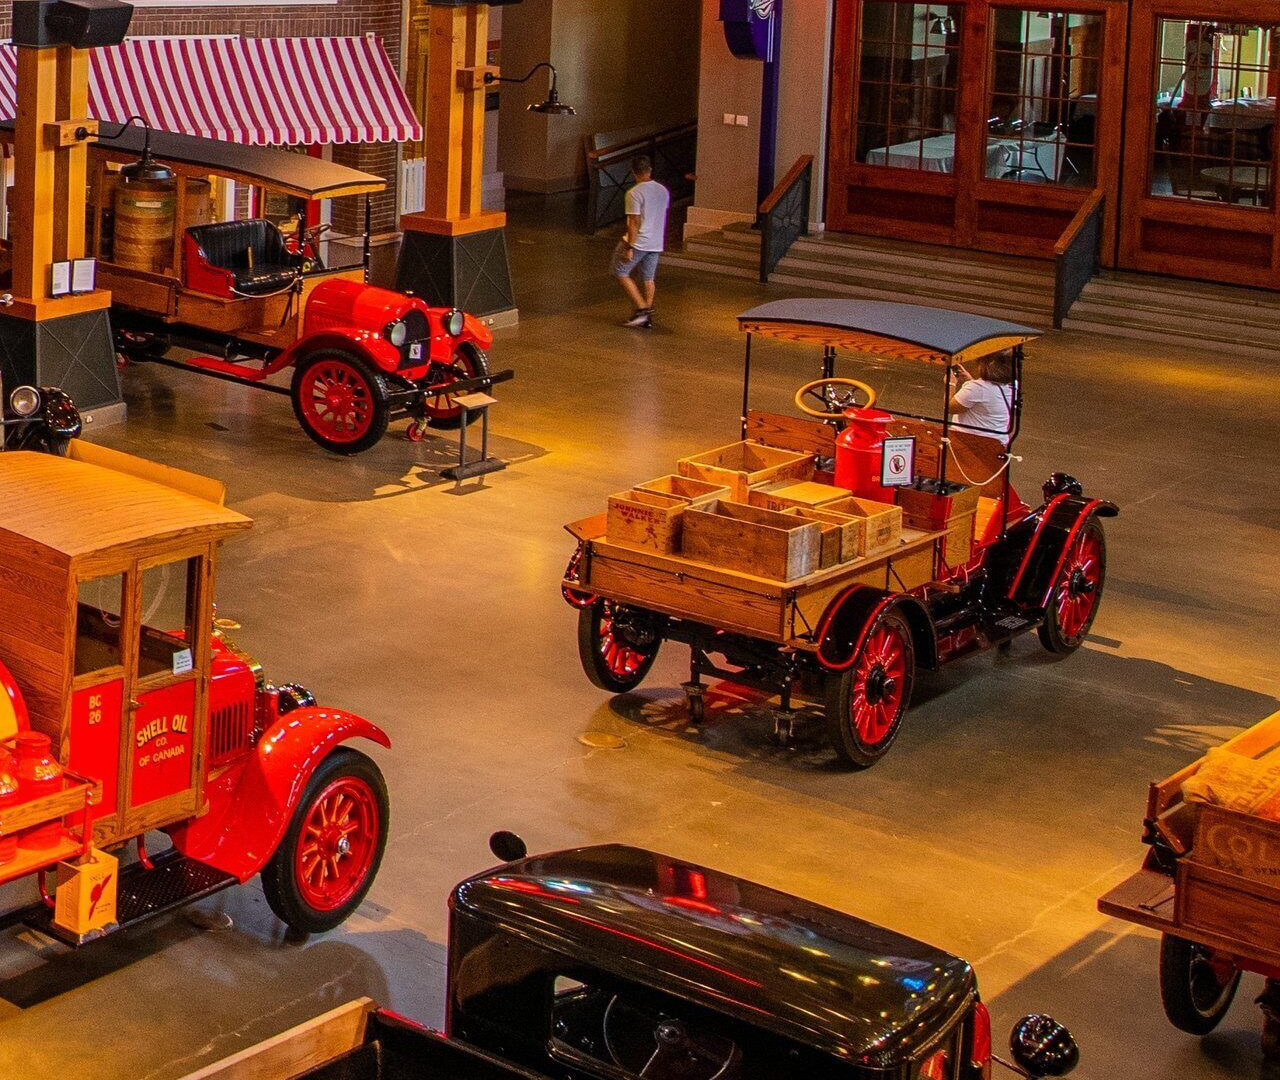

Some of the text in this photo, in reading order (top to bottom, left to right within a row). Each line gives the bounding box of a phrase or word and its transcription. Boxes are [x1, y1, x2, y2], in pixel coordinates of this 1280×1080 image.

[620, 510, 660, 525] WALKER
[88, 694, 101, 709] BC
[88, 711, 101, 725] 26
[136, 715, 188, 748] SHELL OIL
[138, 744, 185, 768] OF CANADA
